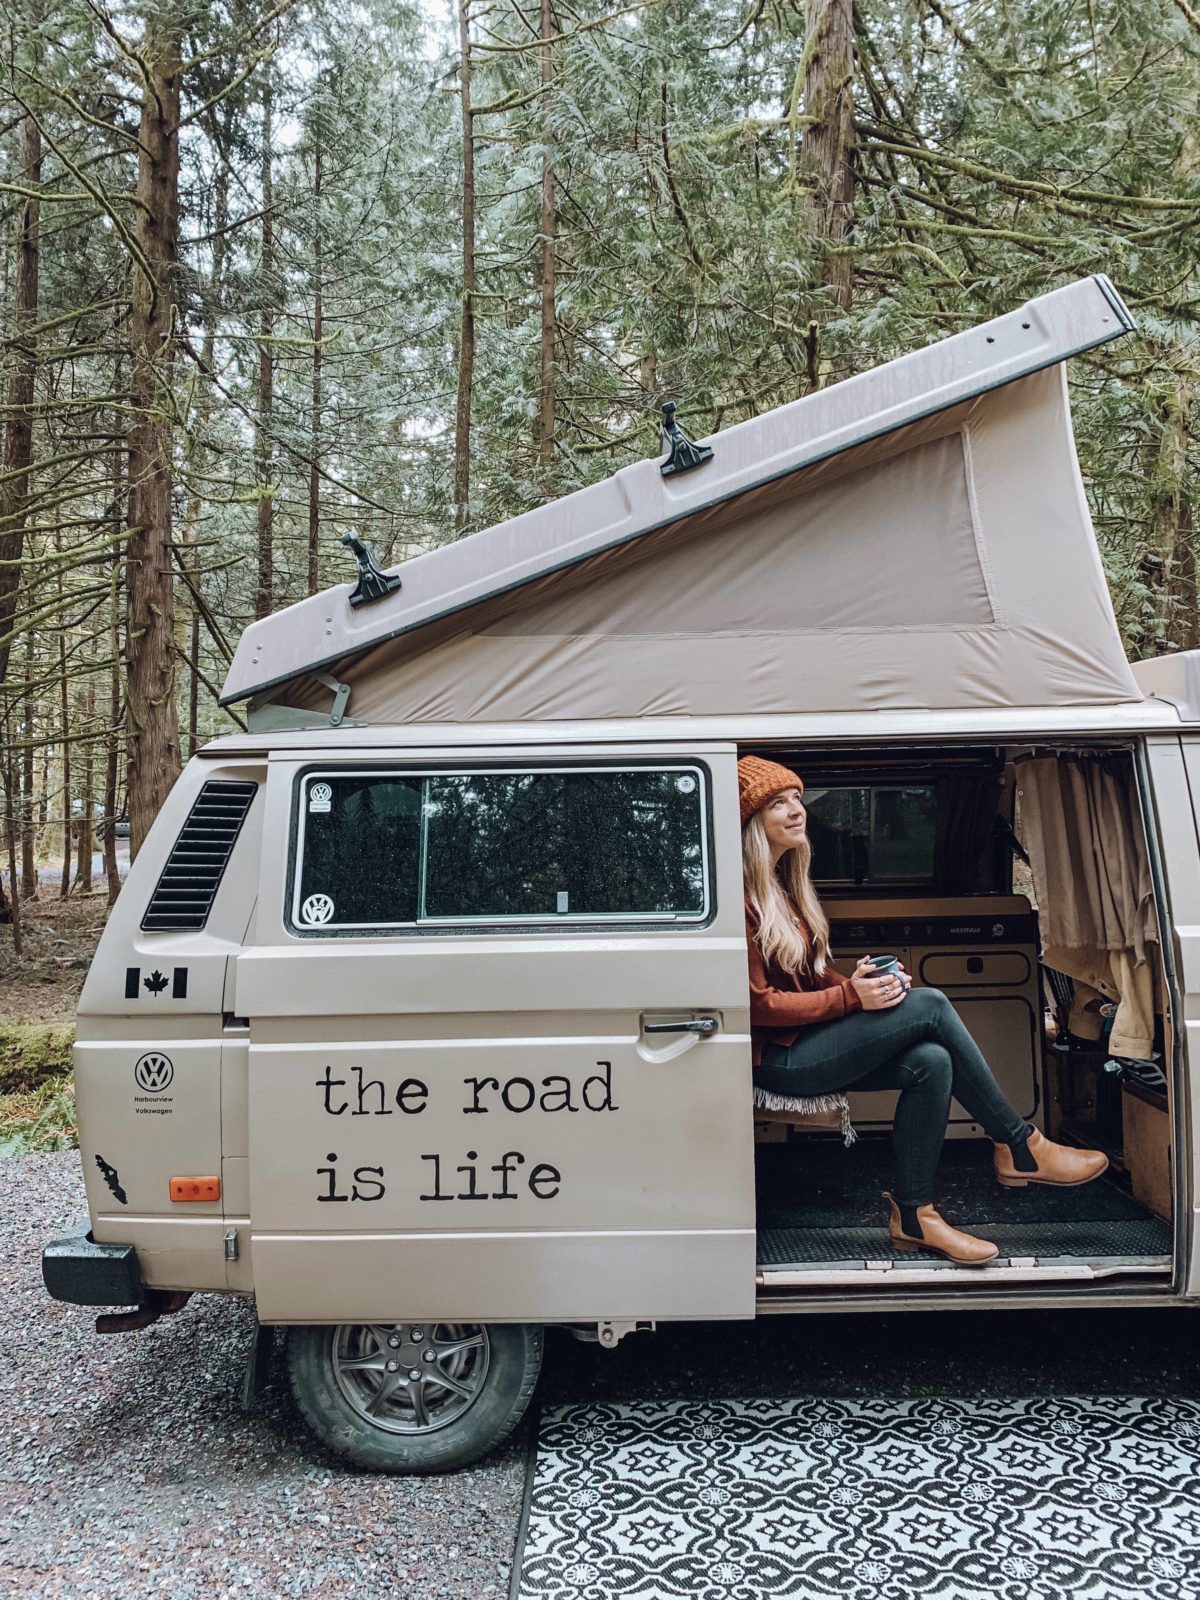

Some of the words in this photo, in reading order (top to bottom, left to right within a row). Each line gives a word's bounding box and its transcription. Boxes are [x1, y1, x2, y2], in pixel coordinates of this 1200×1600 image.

[135, 1107, 173, 1116] Volkswagen
[316, 1066, 429, 1116] the
[463, 1061, 619, 1114] road
[316, 1152, 386, 1202] is
[419, 1150, 562, 1202] life
